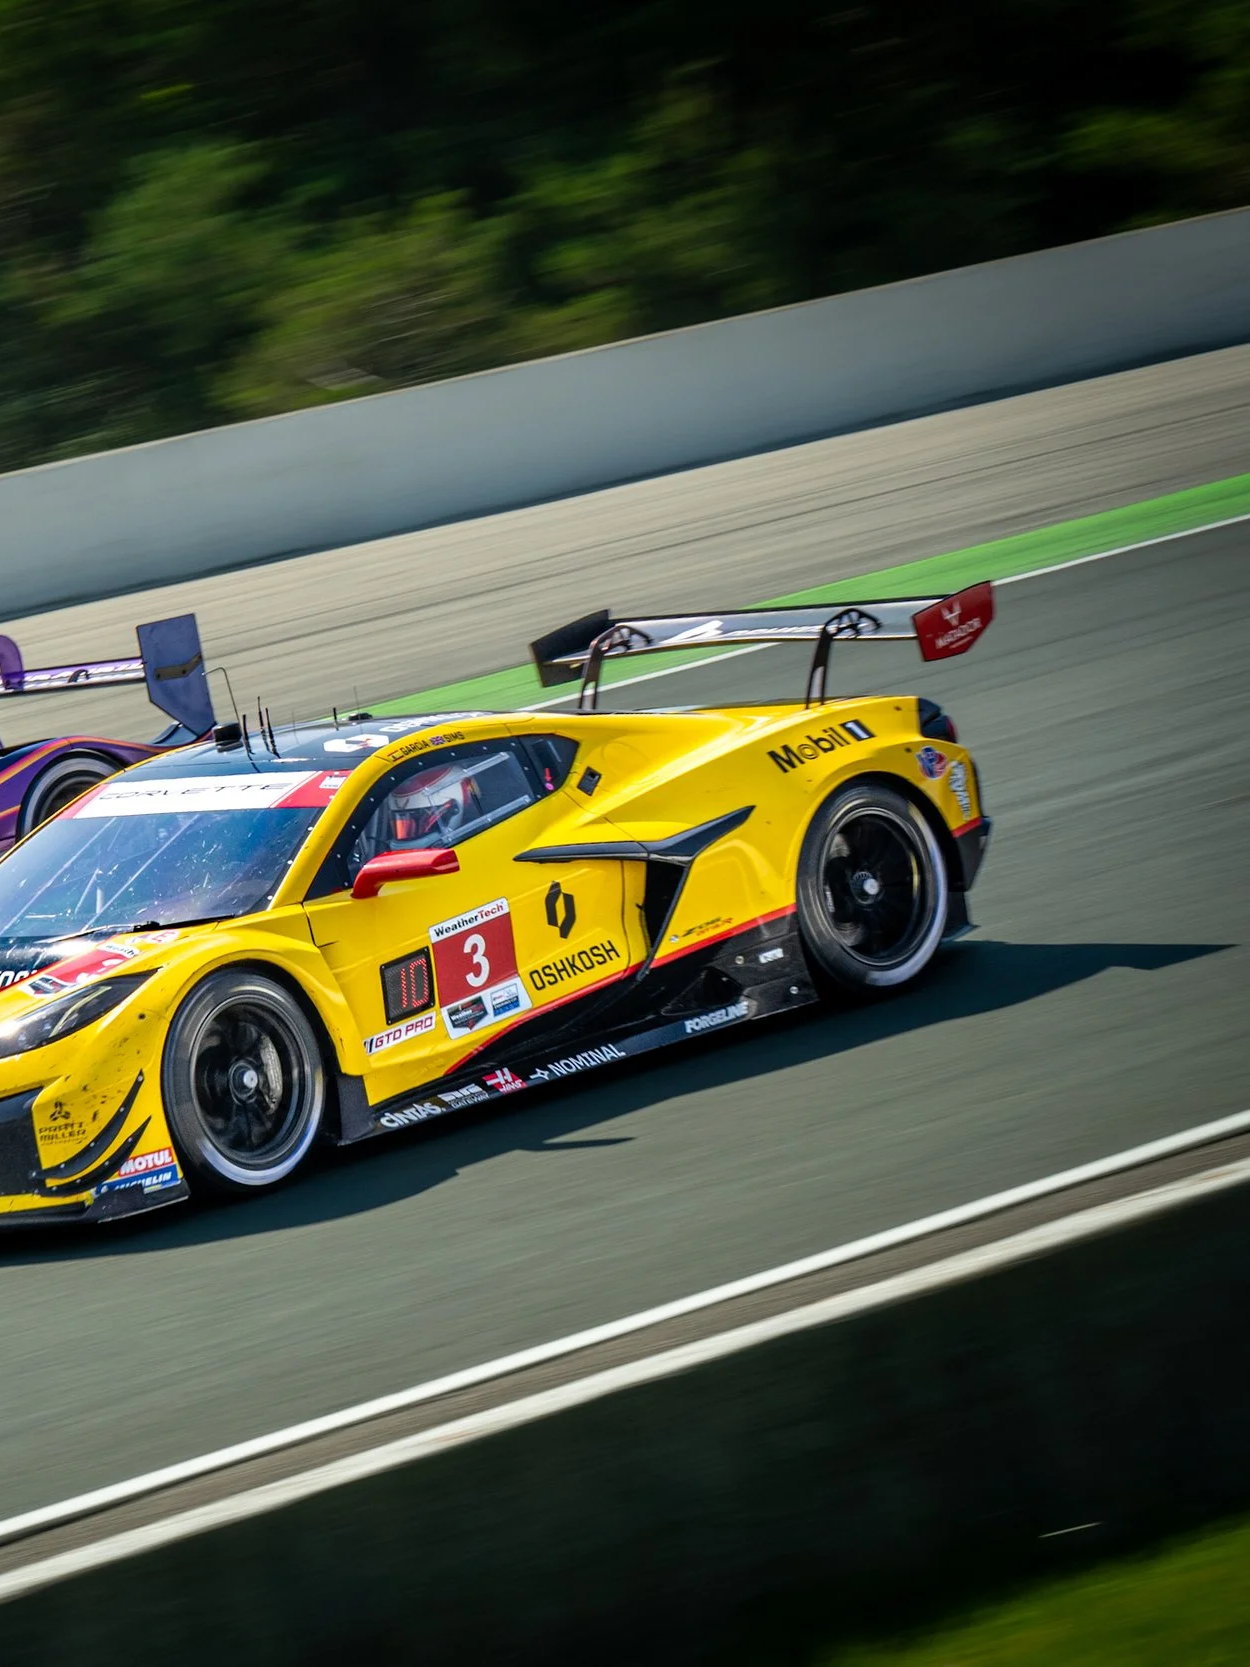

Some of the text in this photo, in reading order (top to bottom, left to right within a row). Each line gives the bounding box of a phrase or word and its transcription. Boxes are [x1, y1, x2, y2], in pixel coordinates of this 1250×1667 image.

[444, 731, 465, 743] SIMS
[767, 720, 872, 773] Mobil 1
[100, 782, 291, 800] CORVETTE
[434, 901, 504, 937] WeatherTech
[463, 933, 490, 988] 3
[529, 940, 620, 991] OSHKOSH
[375, 1029, 402, 1048] GTD
[405, 1016, 433, 1036] PRO
[684, 1001, 748, 1034] FORGELINE
[548, 1044, 626, 1077] NOMINAL
[120, 1150, 172, 1176] MOTUL
